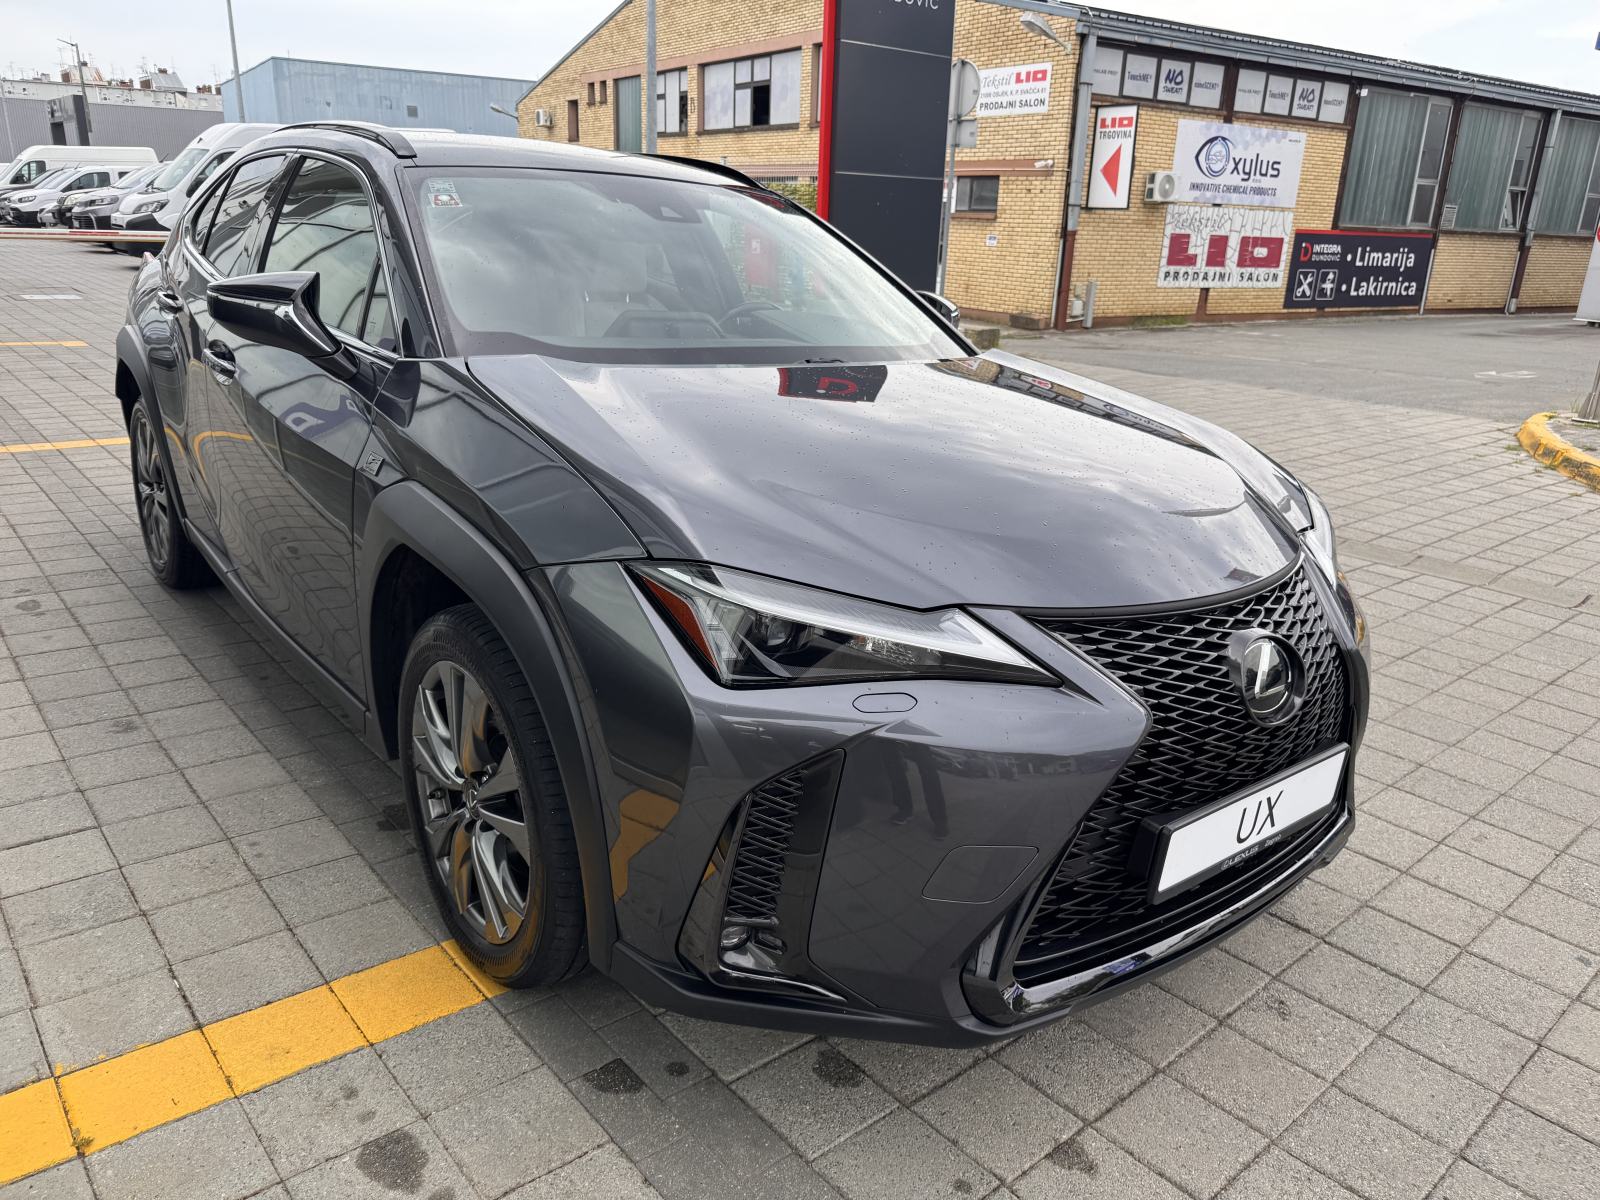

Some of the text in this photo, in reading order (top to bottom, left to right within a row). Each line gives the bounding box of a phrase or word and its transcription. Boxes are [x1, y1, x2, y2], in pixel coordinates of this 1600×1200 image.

[983, 69, 1047, 90] Tekstil LIO
[1164, 68, 1184, 86] NO
[1299, 87, 1315, 103] NO
[979, 98, 1046, 111] PRODAJNI SALON
[1100, 116, 1134, 129] LIO
[1099, 130, 1132, 140] TRGOVINA
[1189, 182, 1277, 197] INNOVATIVE CHEMICAL PRODUCTS
[1166, 233, 1284, 268] LIO
[1312, 243, 1342, 253] INTEGRA
[1355, 246, 1415, 272] Limarija
[1163, 271, 1279, 282] PRODAJNI SALON
[1349, 275, 1417, 297] Lakirnica
[1236, 789, 1284, 844] UX
